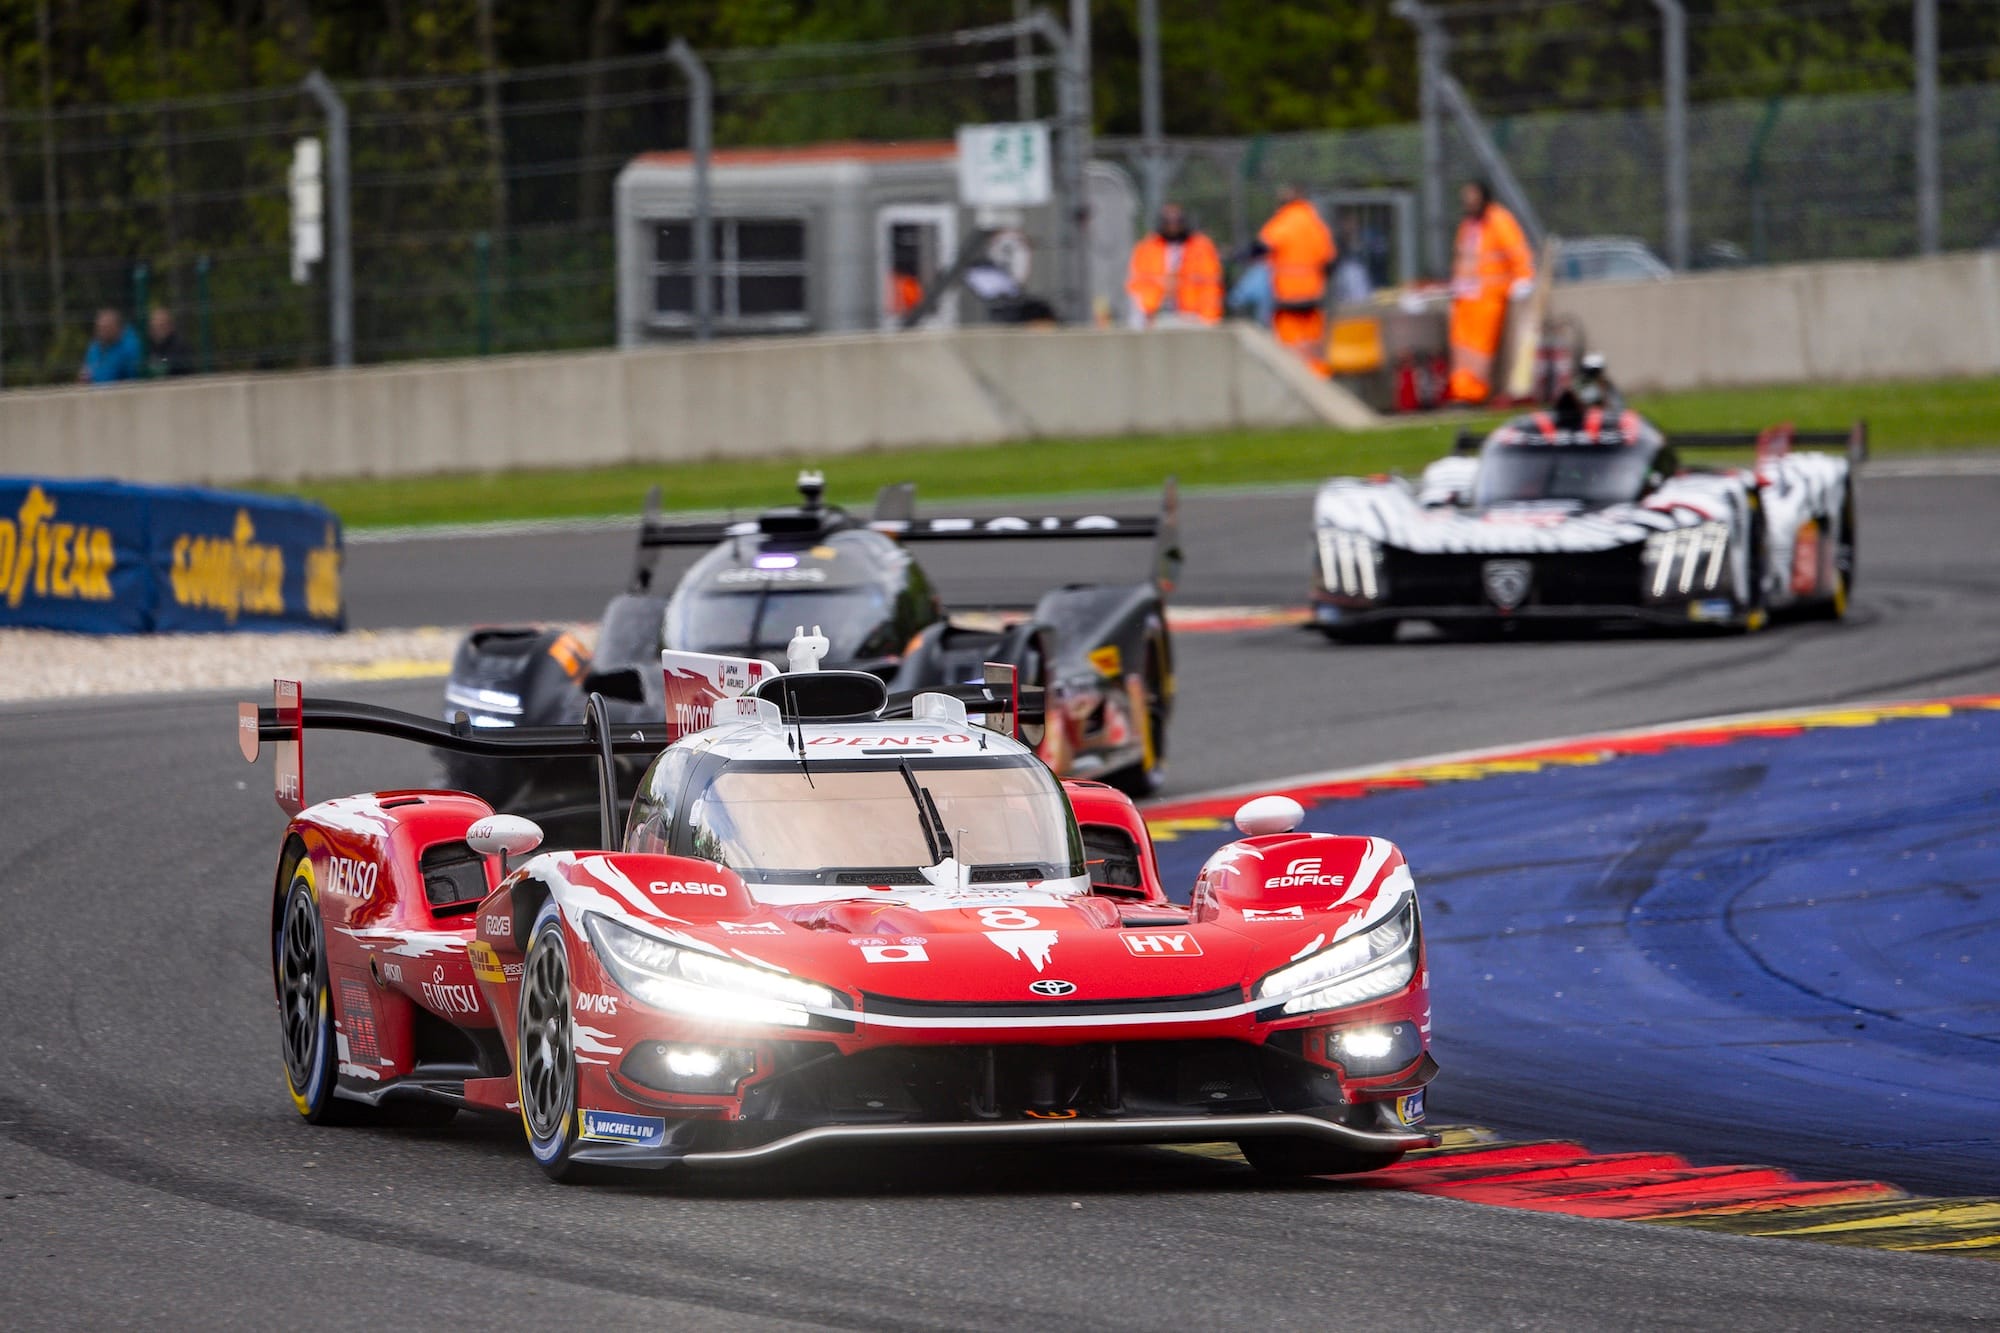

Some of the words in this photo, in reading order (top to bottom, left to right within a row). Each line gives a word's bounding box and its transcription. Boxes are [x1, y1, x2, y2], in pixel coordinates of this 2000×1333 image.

[726, 665, 738, 675] JAPAN
[727, 679, 744, 689] AIRLINES
[736, 699, 757, 716] TOYOTA
[807, 734, 970, 746] DENSO
[278, 773, 298, 802] JFE
[467, 825, 493, 840] ENSO
[327, 855, 378, 900] DENSO
[1264, 875, 1345, 889] EDIFICE
[649, 881, 728, 897] CASIO
[485, 914, 511, 937] RAYS
[976, 907, 1041, 930] 8
[1126, 934, 1187, 952] HY
[421, 981, 480, 1018] FUJITSU
[596, 1120, 655, 1138] MICHELIN
